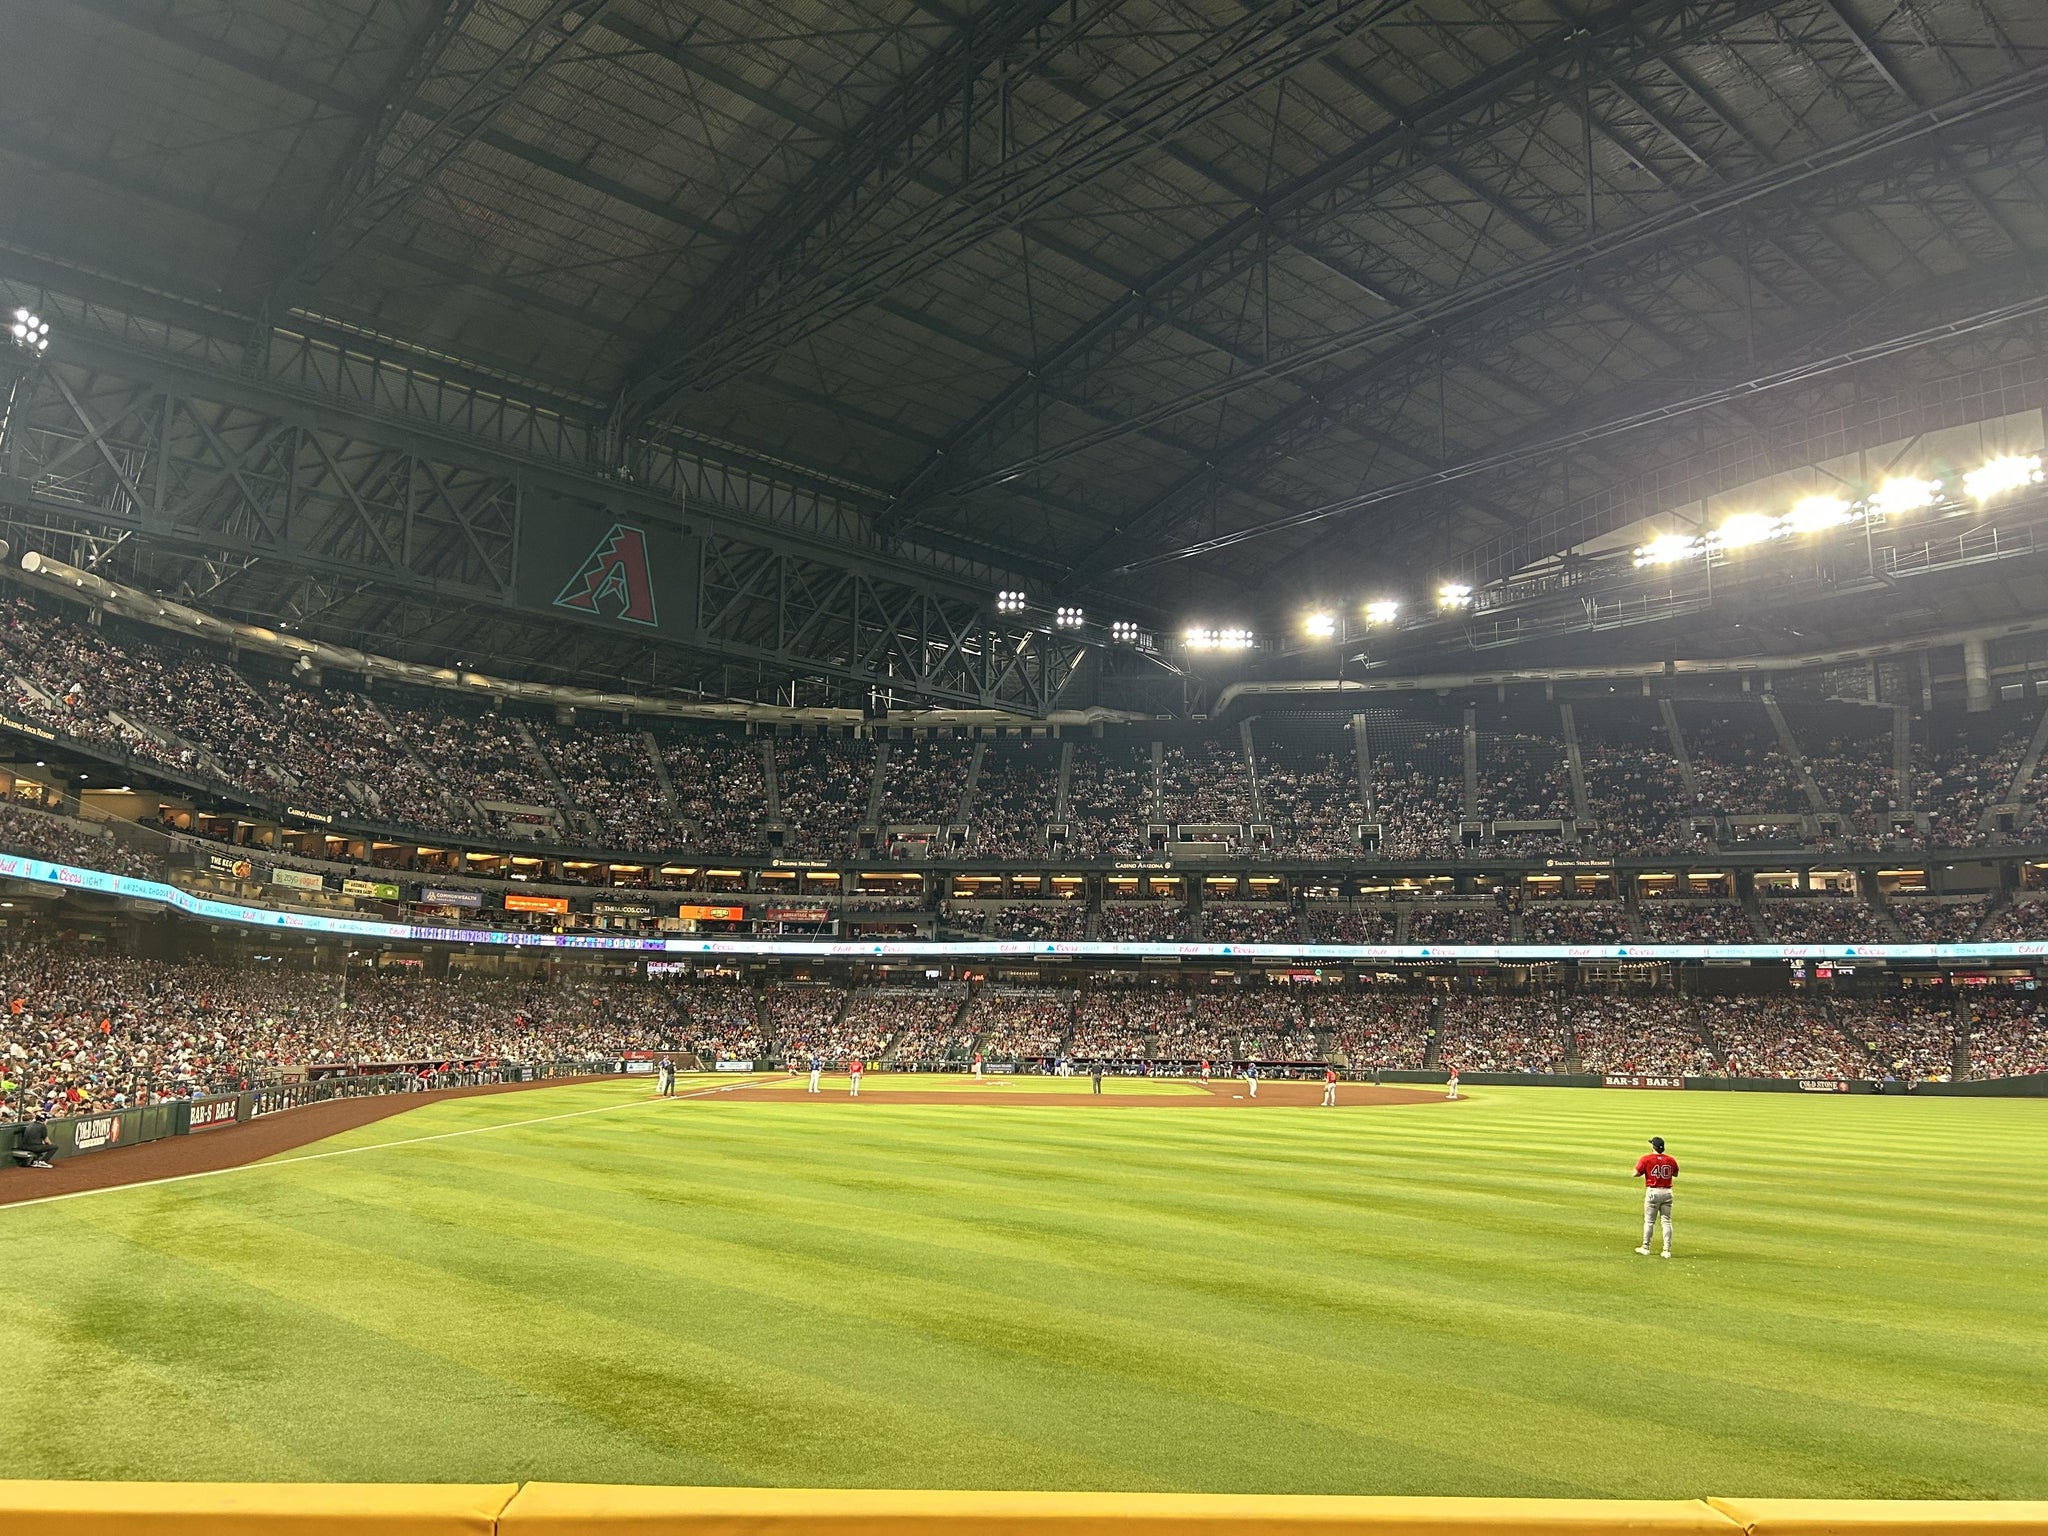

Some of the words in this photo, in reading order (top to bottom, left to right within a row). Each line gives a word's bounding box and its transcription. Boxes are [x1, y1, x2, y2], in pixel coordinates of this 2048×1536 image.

[37, 728, 55, 740] RESORT
[287, 807, 305, 817] CASINO
[305, 811, 326, 822] ARIZONA
[0, 860, 17, 873] hill
[211, 856, 222, 865] THE
[222, 859, 233, 868] KEG
[59, 868, 82, 884] Coors
[82, 876, 103, 887] LIGHT
[2018, 944, 2045, 954] Chill
[1606, 1077, 1639, 1086] BAR-S
[1646, 1078, 1680, 1087] BAR-S
[1799, 1080, 1817, 1089] COLD
[1817, 1081, 1838, 1090] STONE
[190, 1104, 213, 1125] BAR-S
[215, 1100, 236, 1120] BAR-S
[75, 1121, 92, 1146] COLD
[92, 1117, 112, 1139] STONE
[1650, 1164, 1672, 1179] 40
